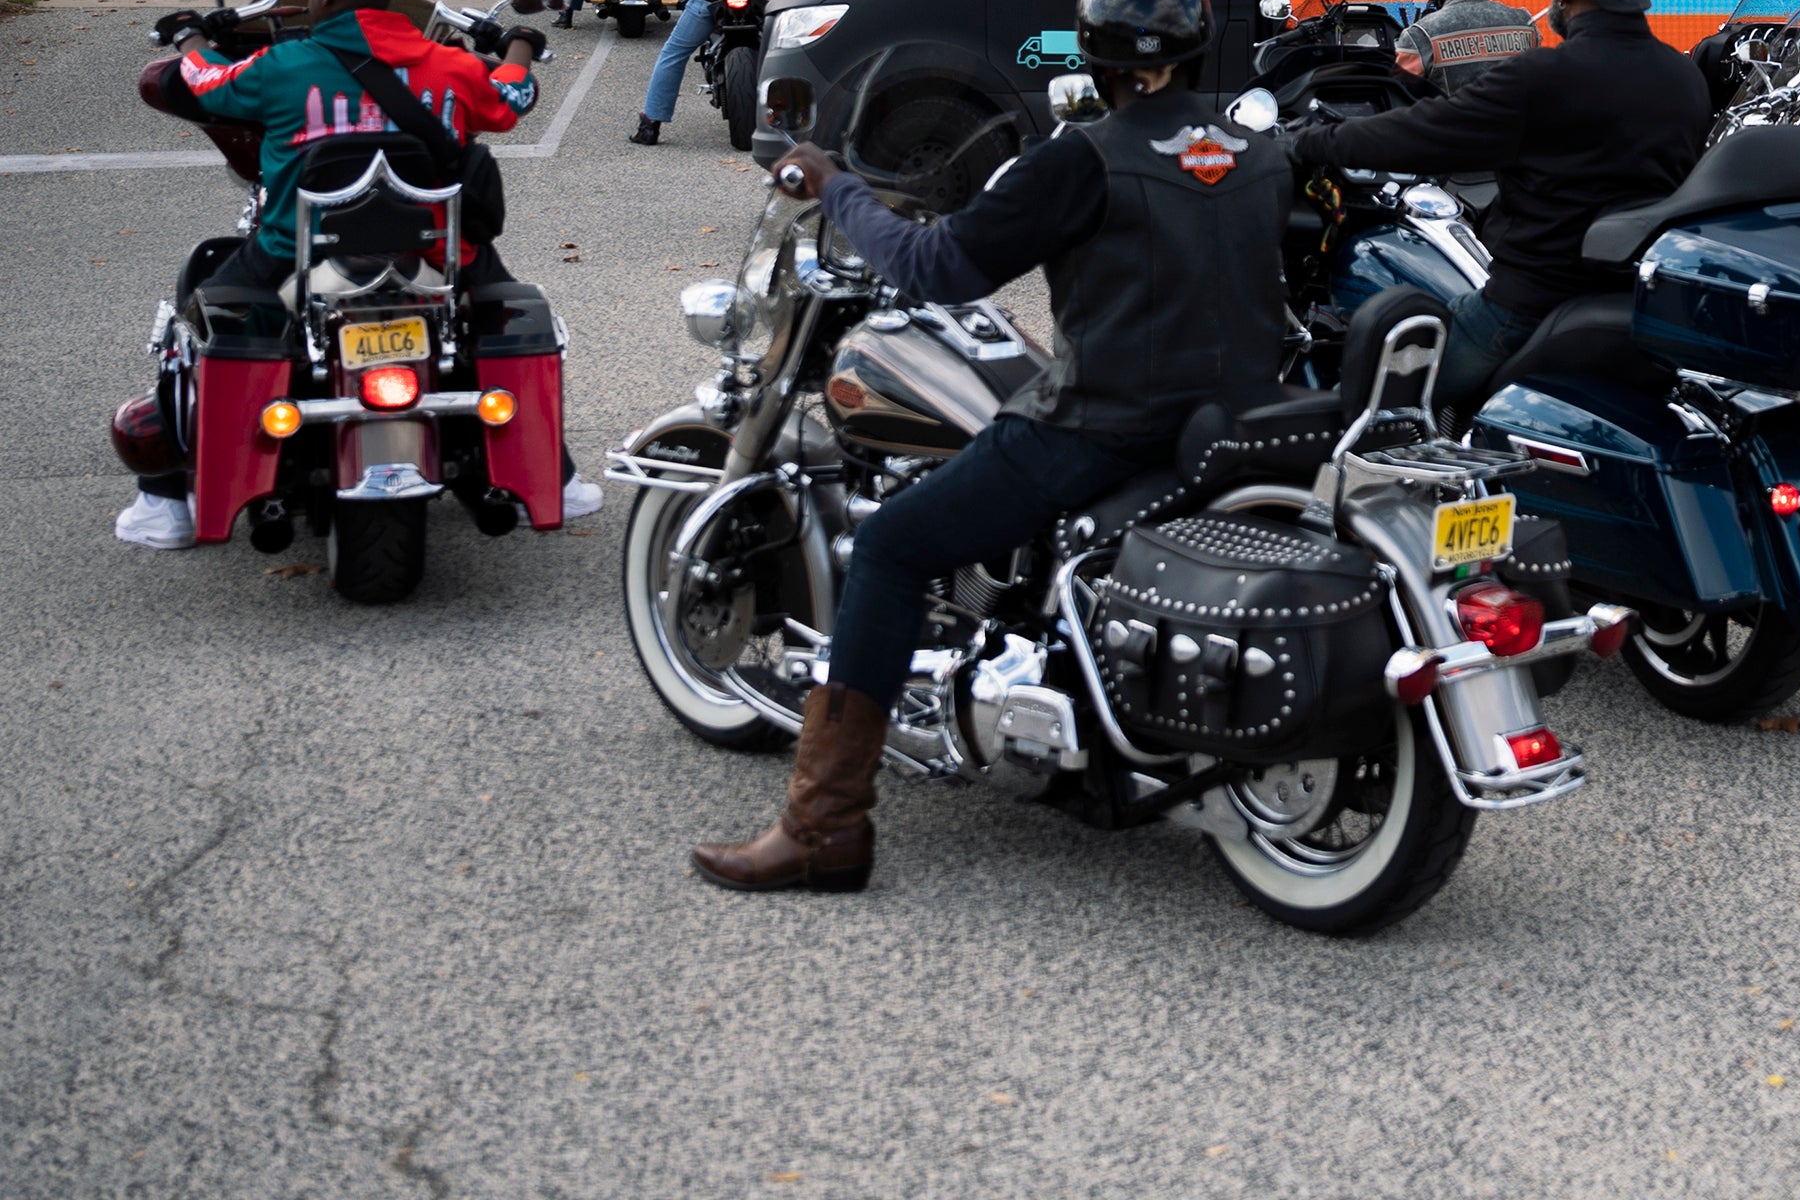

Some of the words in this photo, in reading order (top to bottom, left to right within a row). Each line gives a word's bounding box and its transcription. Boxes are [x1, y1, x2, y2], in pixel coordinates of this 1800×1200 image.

[1439, 32, 1533, 59] HARLEY-DAVIDSON
[357, 332, 414, 355] 4LLC6
[1445, 517, 1500, 551] 4VFC6
